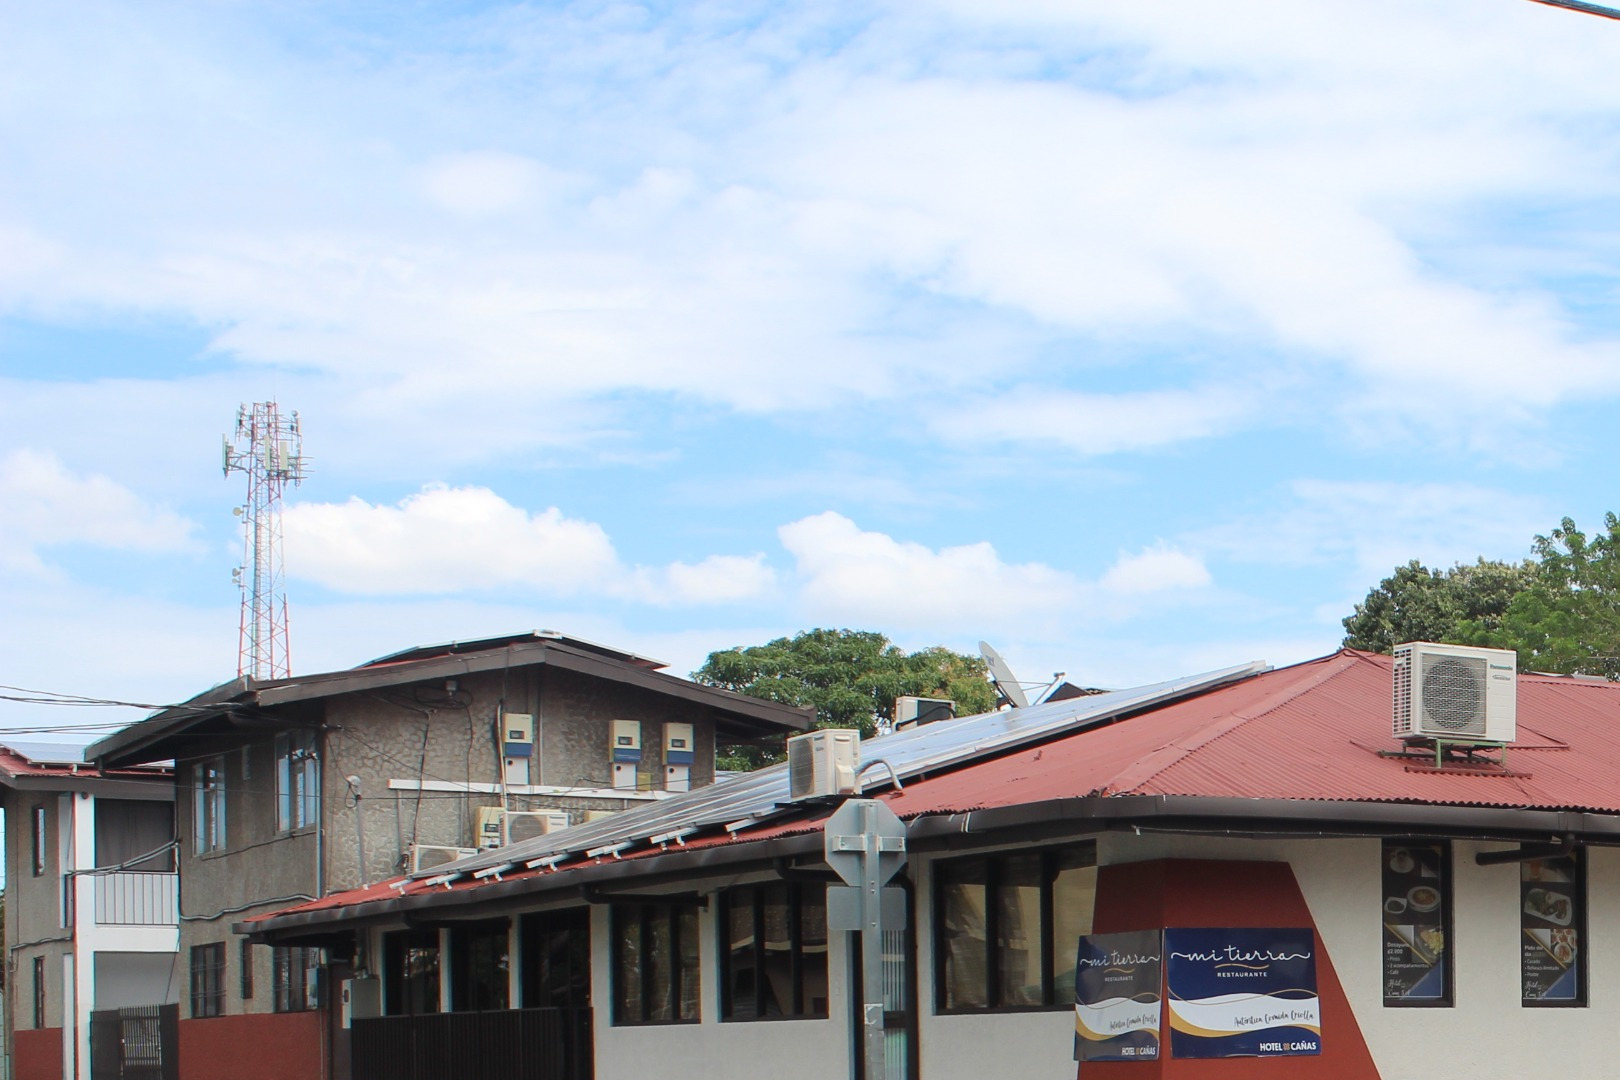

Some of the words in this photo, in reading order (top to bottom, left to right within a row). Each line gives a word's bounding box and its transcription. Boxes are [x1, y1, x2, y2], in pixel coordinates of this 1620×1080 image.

[1080, 955, 1110, 967] mi
[1110, 949, 1160, 966] tierra
[1171, 949, 1223, 961] mi
[1223, 944, 1311, 961] tierra
[1121, 1047, 1136, 1057] HOTEL
[1139, 1044, 1156, 1056] CAÑAS
[1260, 1042, 1282, 1052] HOTEL
[1290, 1040, 1317, 1051] CAÑAS
